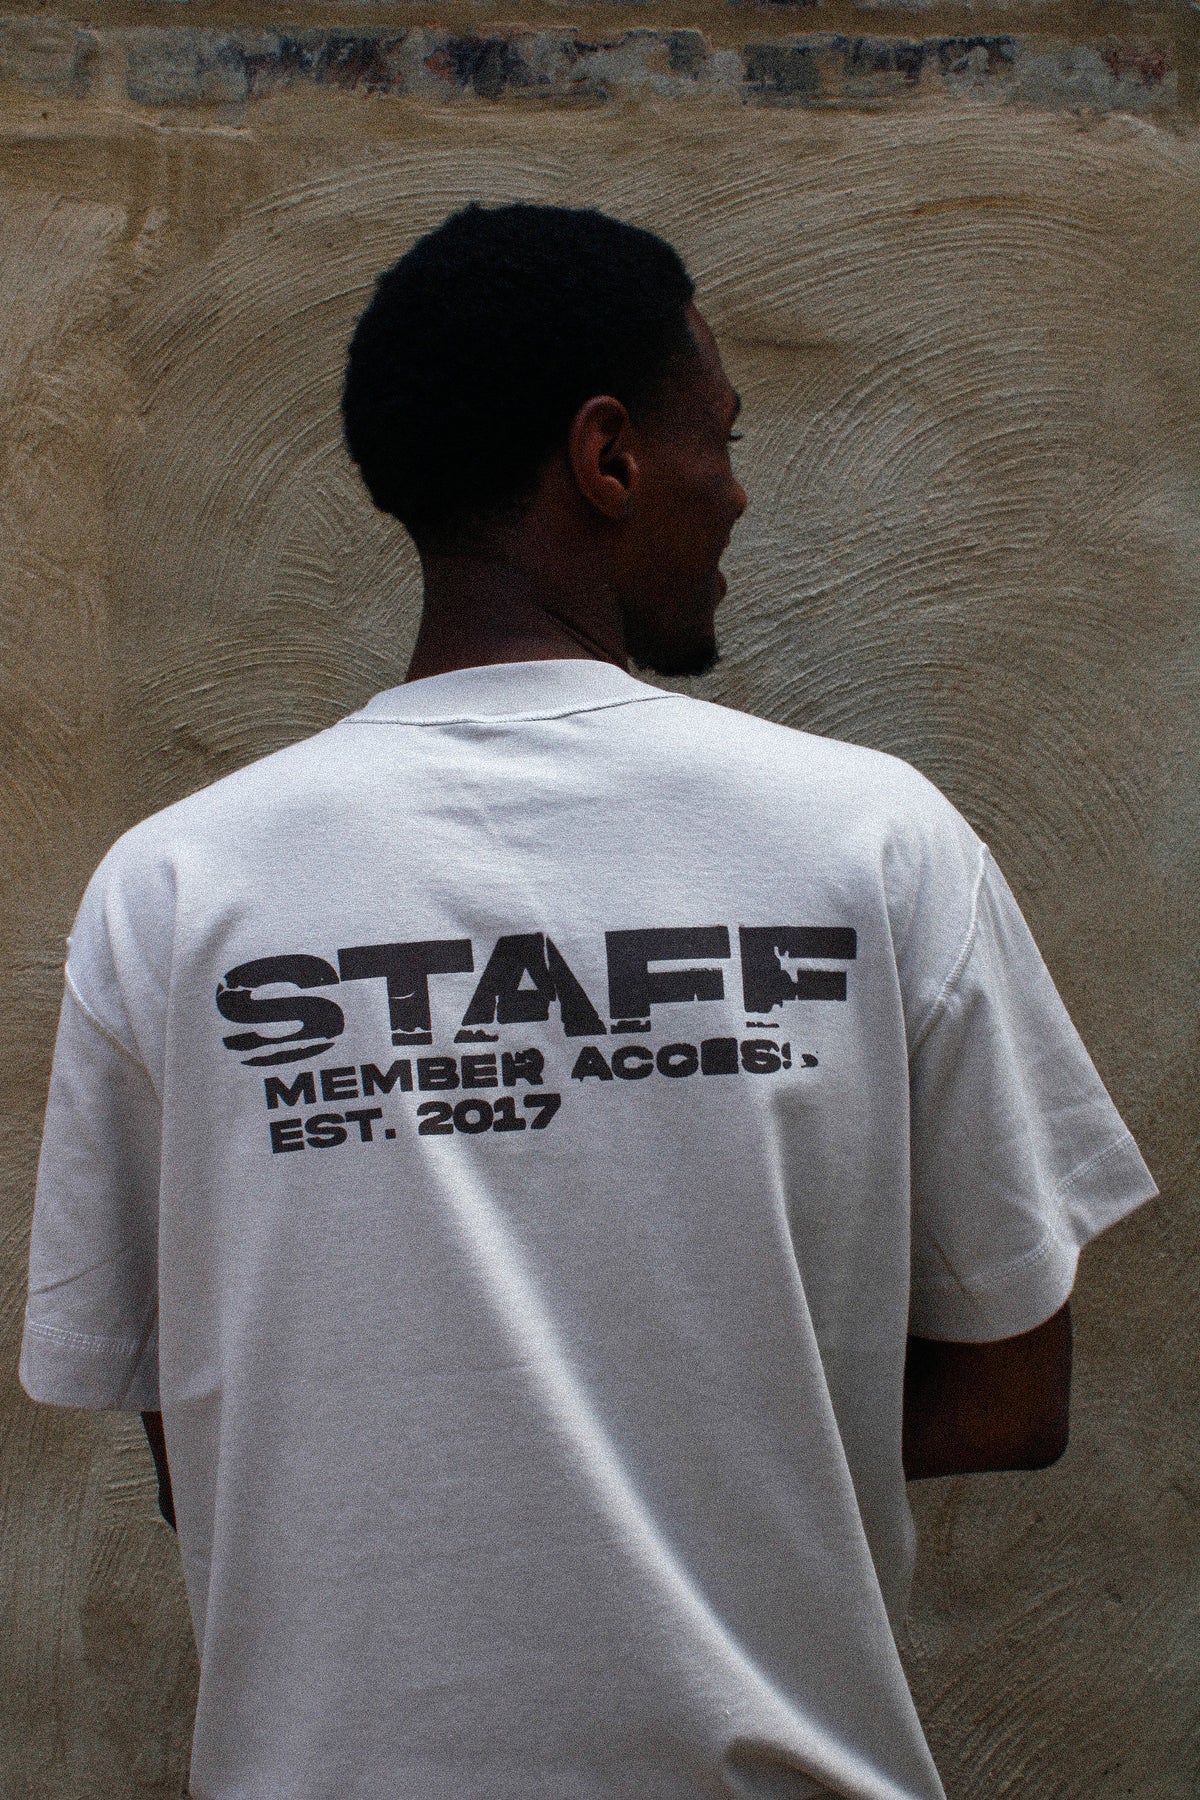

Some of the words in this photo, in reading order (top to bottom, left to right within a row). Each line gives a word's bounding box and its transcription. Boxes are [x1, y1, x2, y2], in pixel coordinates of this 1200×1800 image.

[216, 926, 857, 1067] STAFF
[264, 1048, 545, 1110] MEMBER
[269, 1107, 396, 1154] EST.
[416, 1093, 561, 1136] 2017
